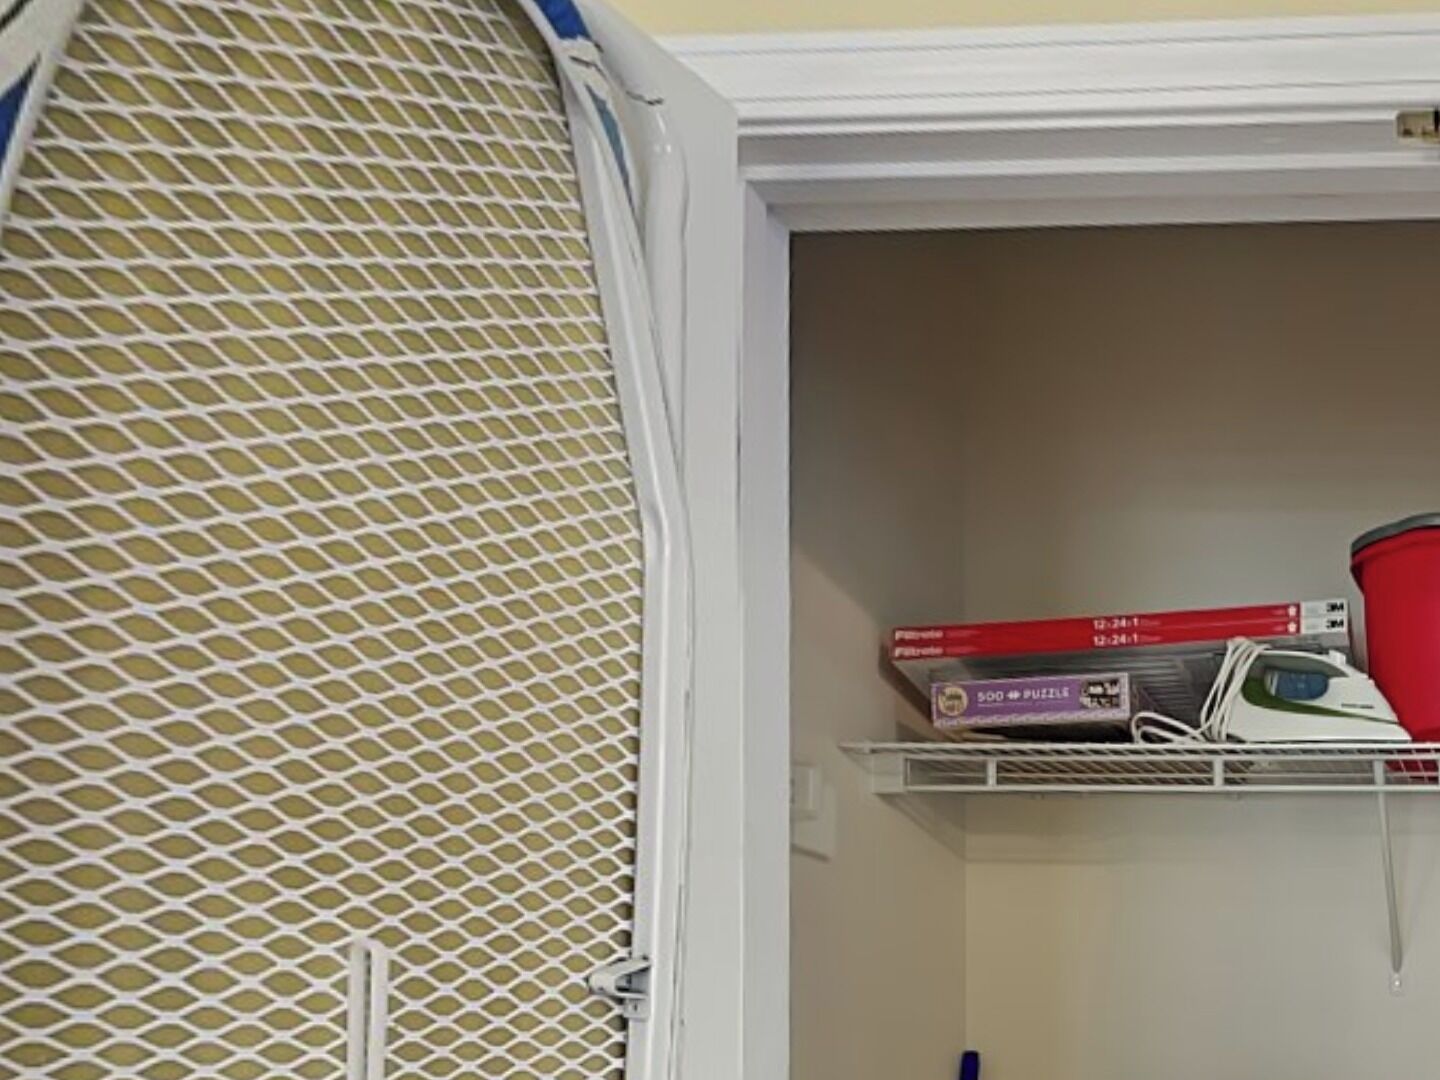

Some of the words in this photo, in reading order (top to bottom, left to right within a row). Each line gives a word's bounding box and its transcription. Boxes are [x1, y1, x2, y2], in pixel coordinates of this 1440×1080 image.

[1326, 602, 1345, 612] 3M
[1326, 619, 1345, 629] 3M
[976, 691, 1004, 703] 500
[1022, 687, 1070, 699] PUZZLE
